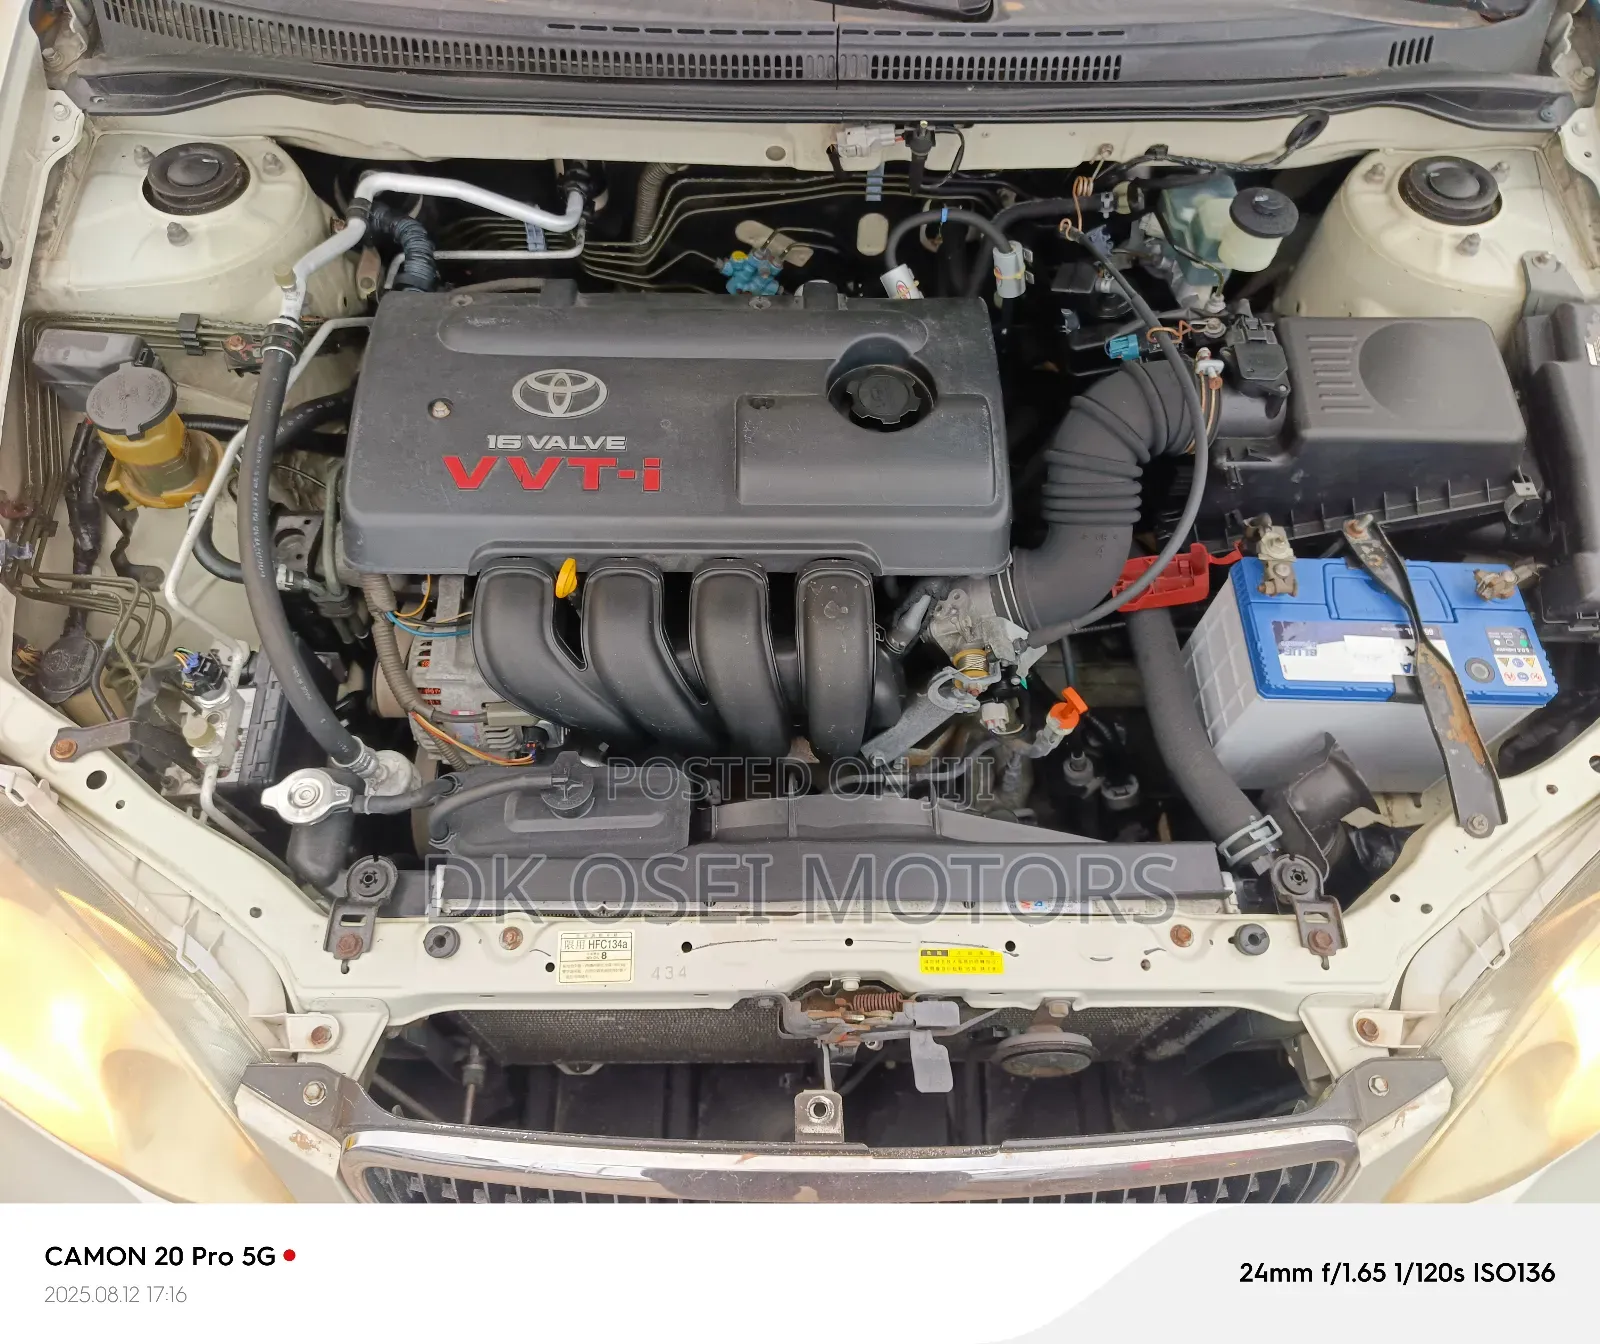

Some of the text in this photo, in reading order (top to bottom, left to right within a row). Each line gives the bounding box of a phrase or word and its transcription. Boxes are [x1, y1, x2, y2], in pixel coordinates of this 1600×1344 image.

[487, 434, 627, 451] 16 VALVE
[442, 455, 662, 492] VVT-i
[588, 939, 628, 950] HFC134a
[601, 951, 607, 960] 8
